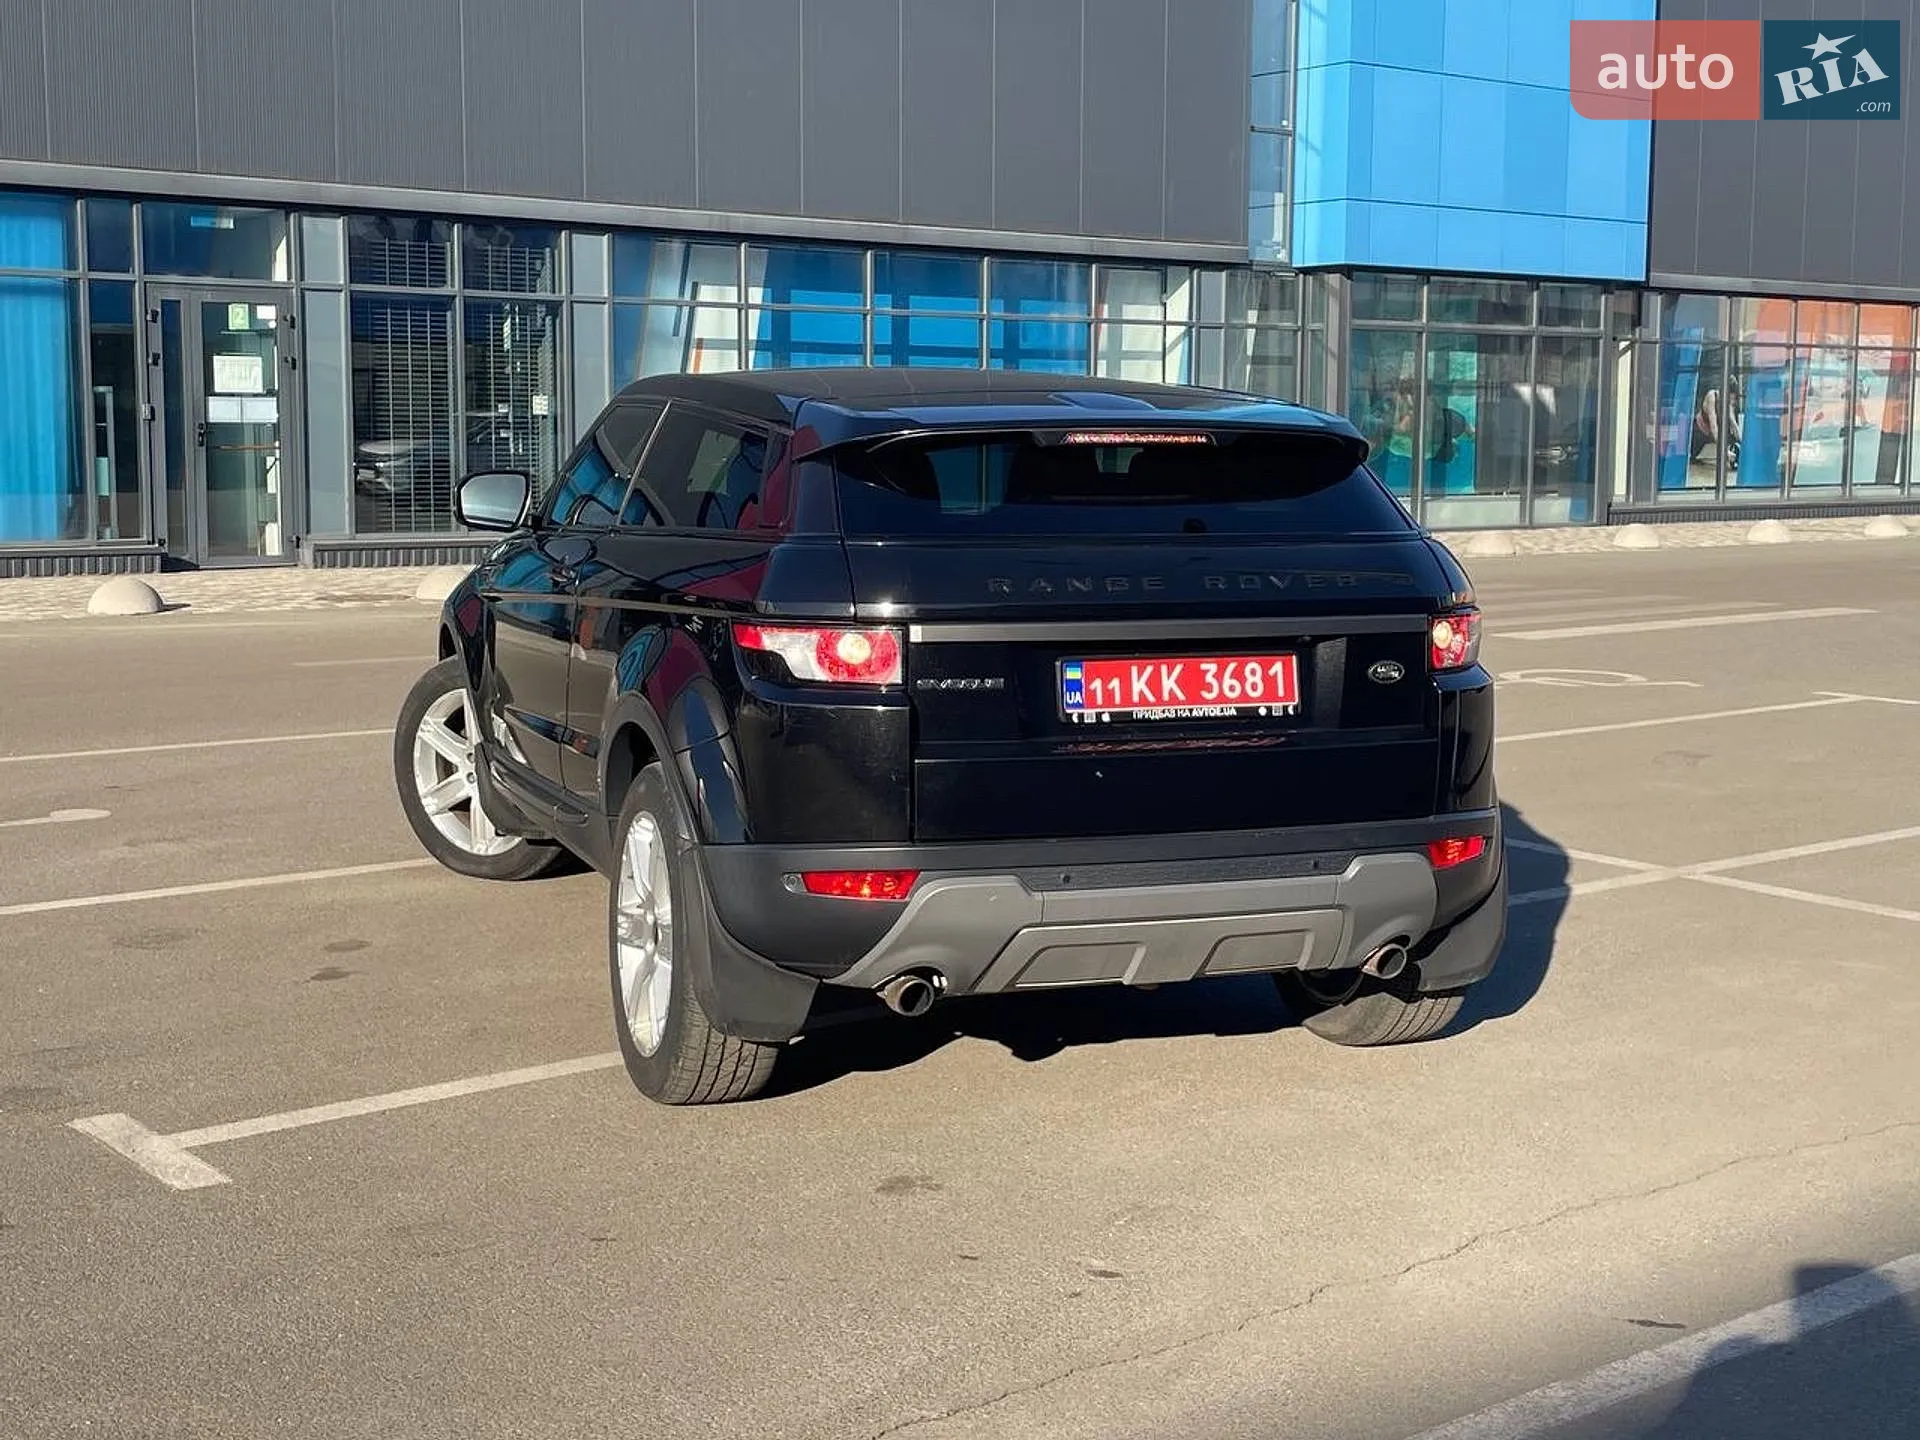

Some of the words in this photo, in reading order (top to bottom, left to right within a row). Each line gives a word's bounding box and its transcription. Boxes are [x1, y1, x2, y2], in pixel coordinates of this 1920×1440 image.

[984, 575, 1166, 592] RANGE
[1203, 574, 1358, 590] ROVER
[1200, 660, 1285, 700] 3681
[1066, 691, 1083, 704] UA
